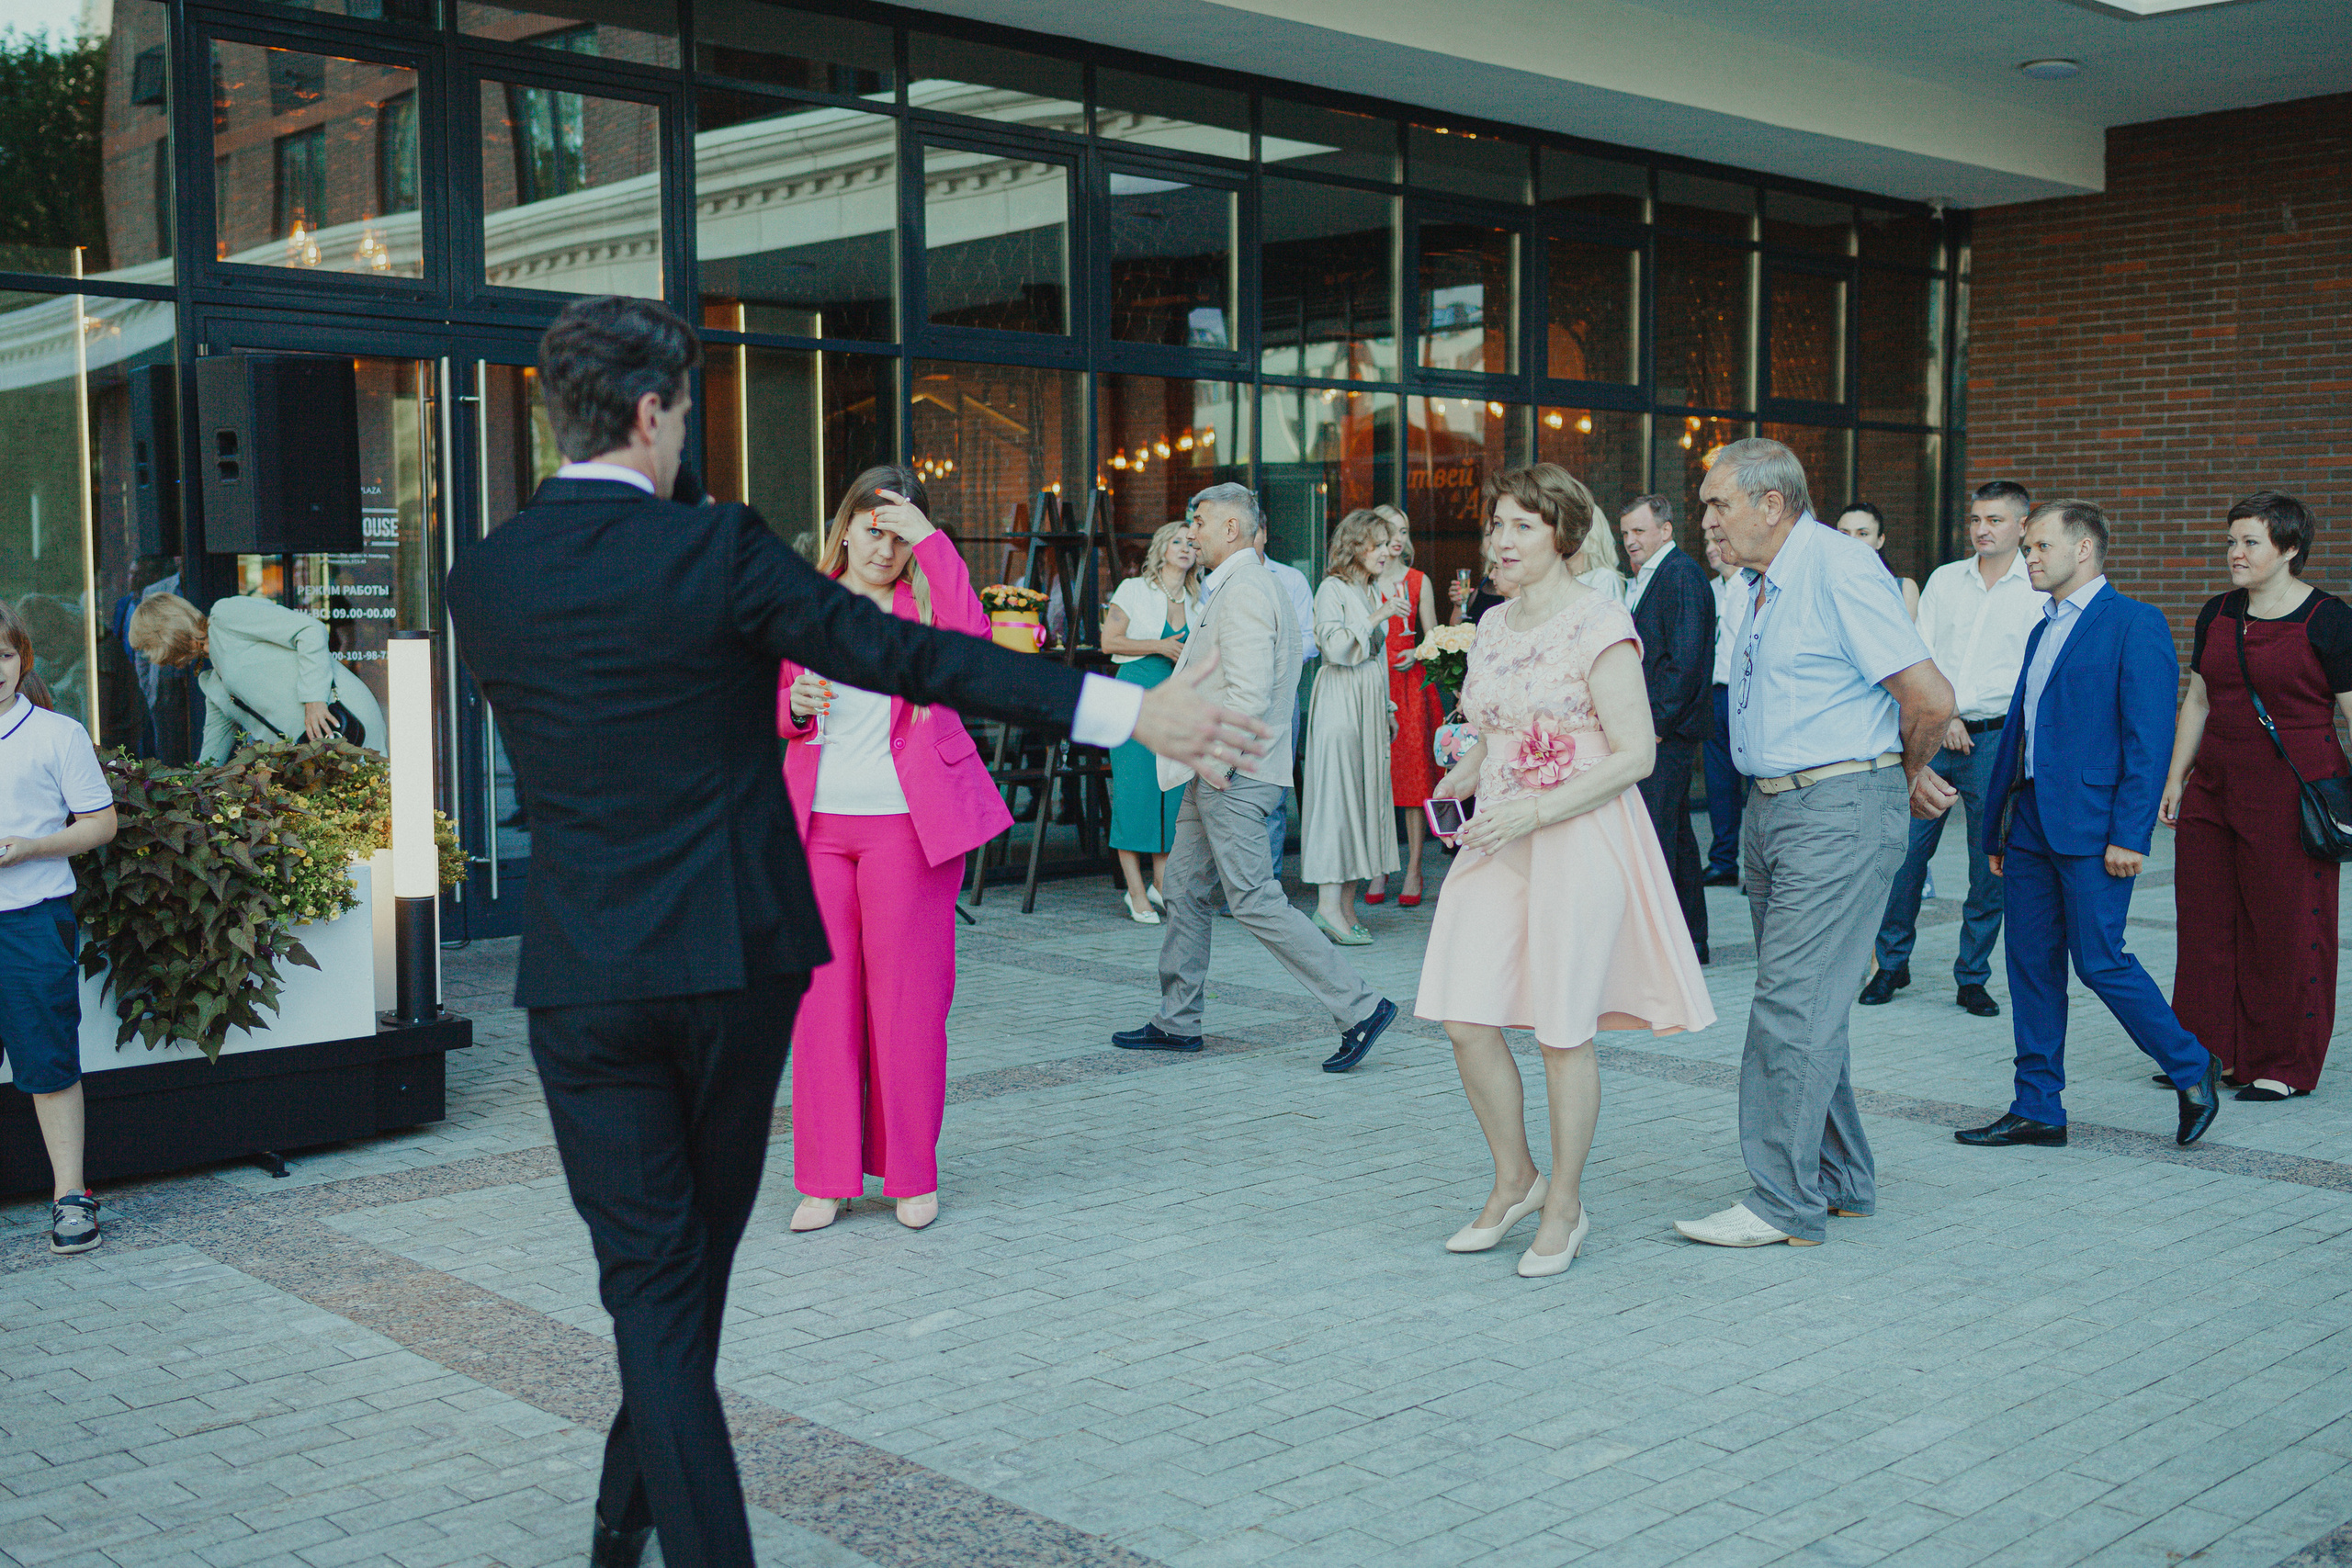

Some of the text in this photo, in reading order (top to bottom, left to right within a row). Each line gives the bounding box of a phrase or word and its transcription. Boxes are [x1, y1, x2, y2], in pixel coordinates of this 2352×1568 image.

[297, 585, 390, 596] РЕЖИМ РАБОТЫ
[333, 608, 397, 619] 09.00-00.00
[329, 650, 389, 661] 00-101-98-7
